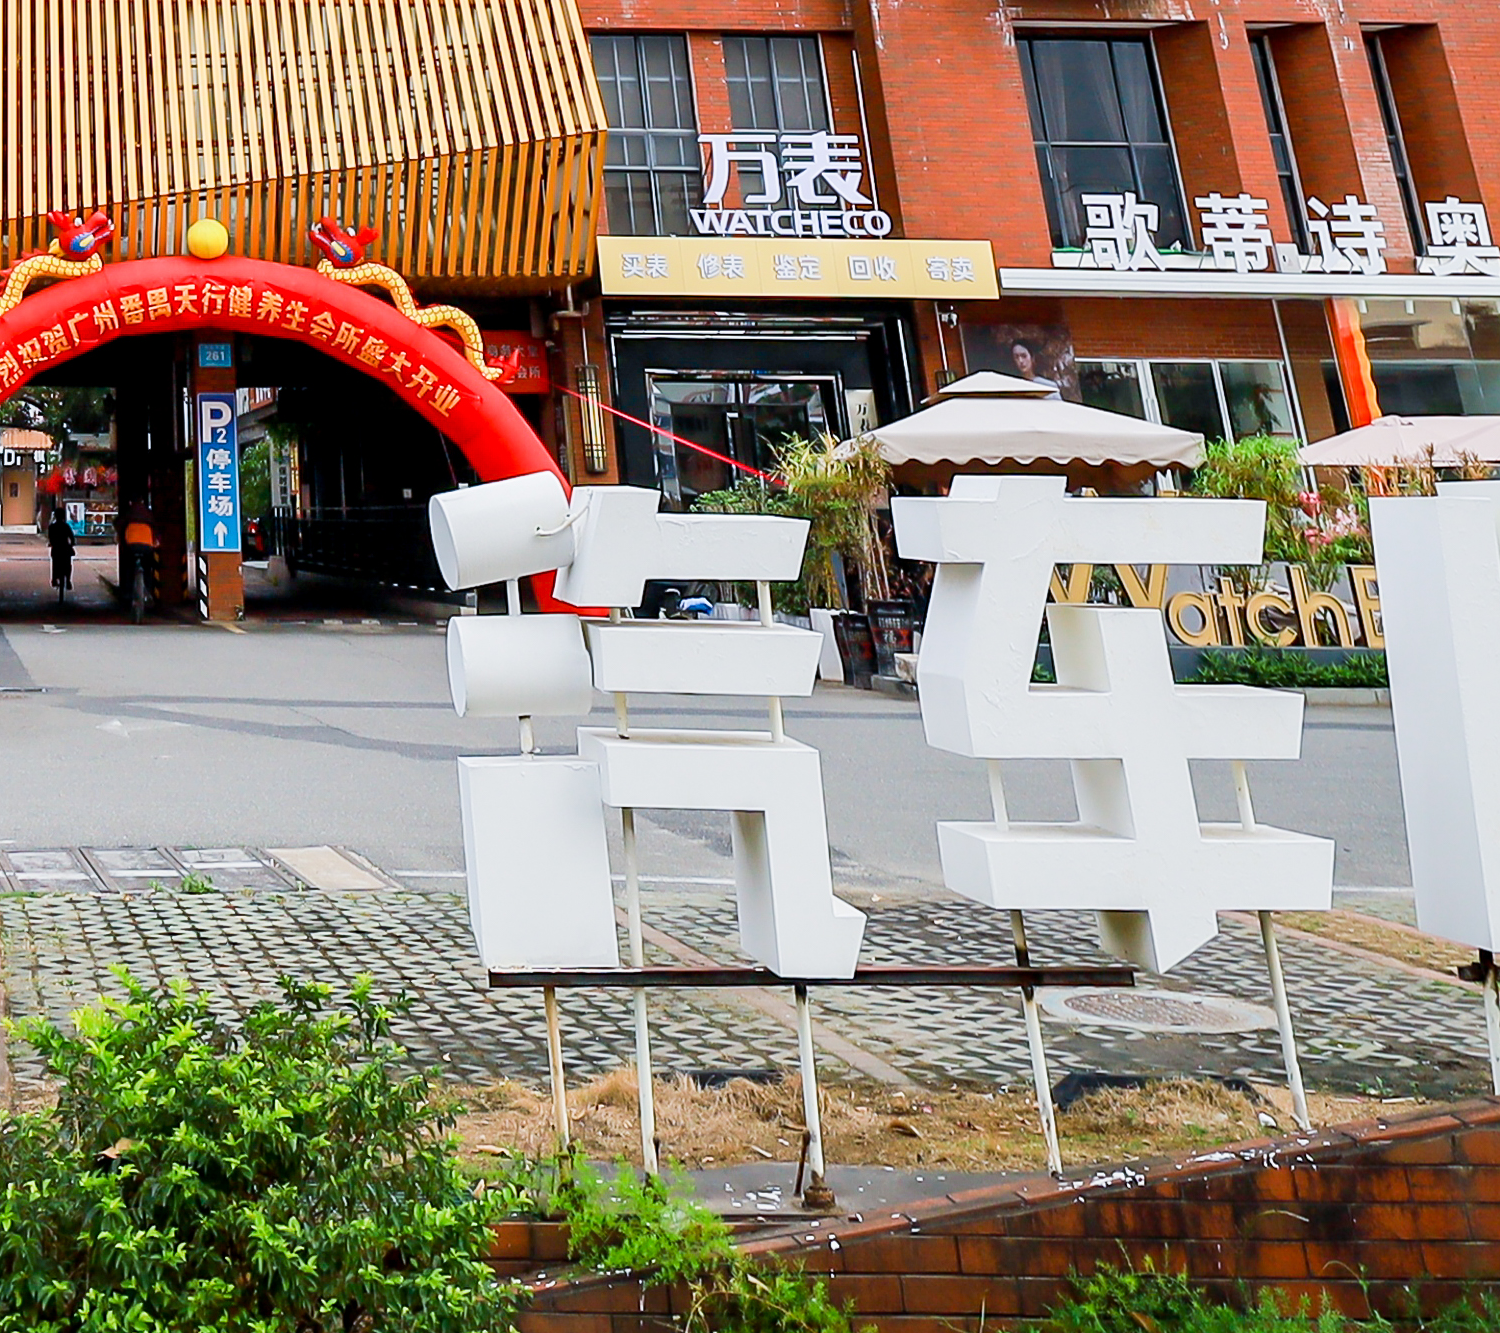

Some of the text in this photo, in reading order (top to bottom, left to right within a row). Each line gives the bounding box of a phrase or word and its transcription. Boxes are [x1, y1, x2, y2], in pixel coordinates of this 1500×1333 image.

[697, 130, 873, 205] 万表
[689, 208, 892, 237] WATCHECO
[621, 252, 976, 283] 买表 修表 鉴定 回收 寄卖
[205, 350, 225, 361] 261
[206, 448, 234, 517] 停车场
